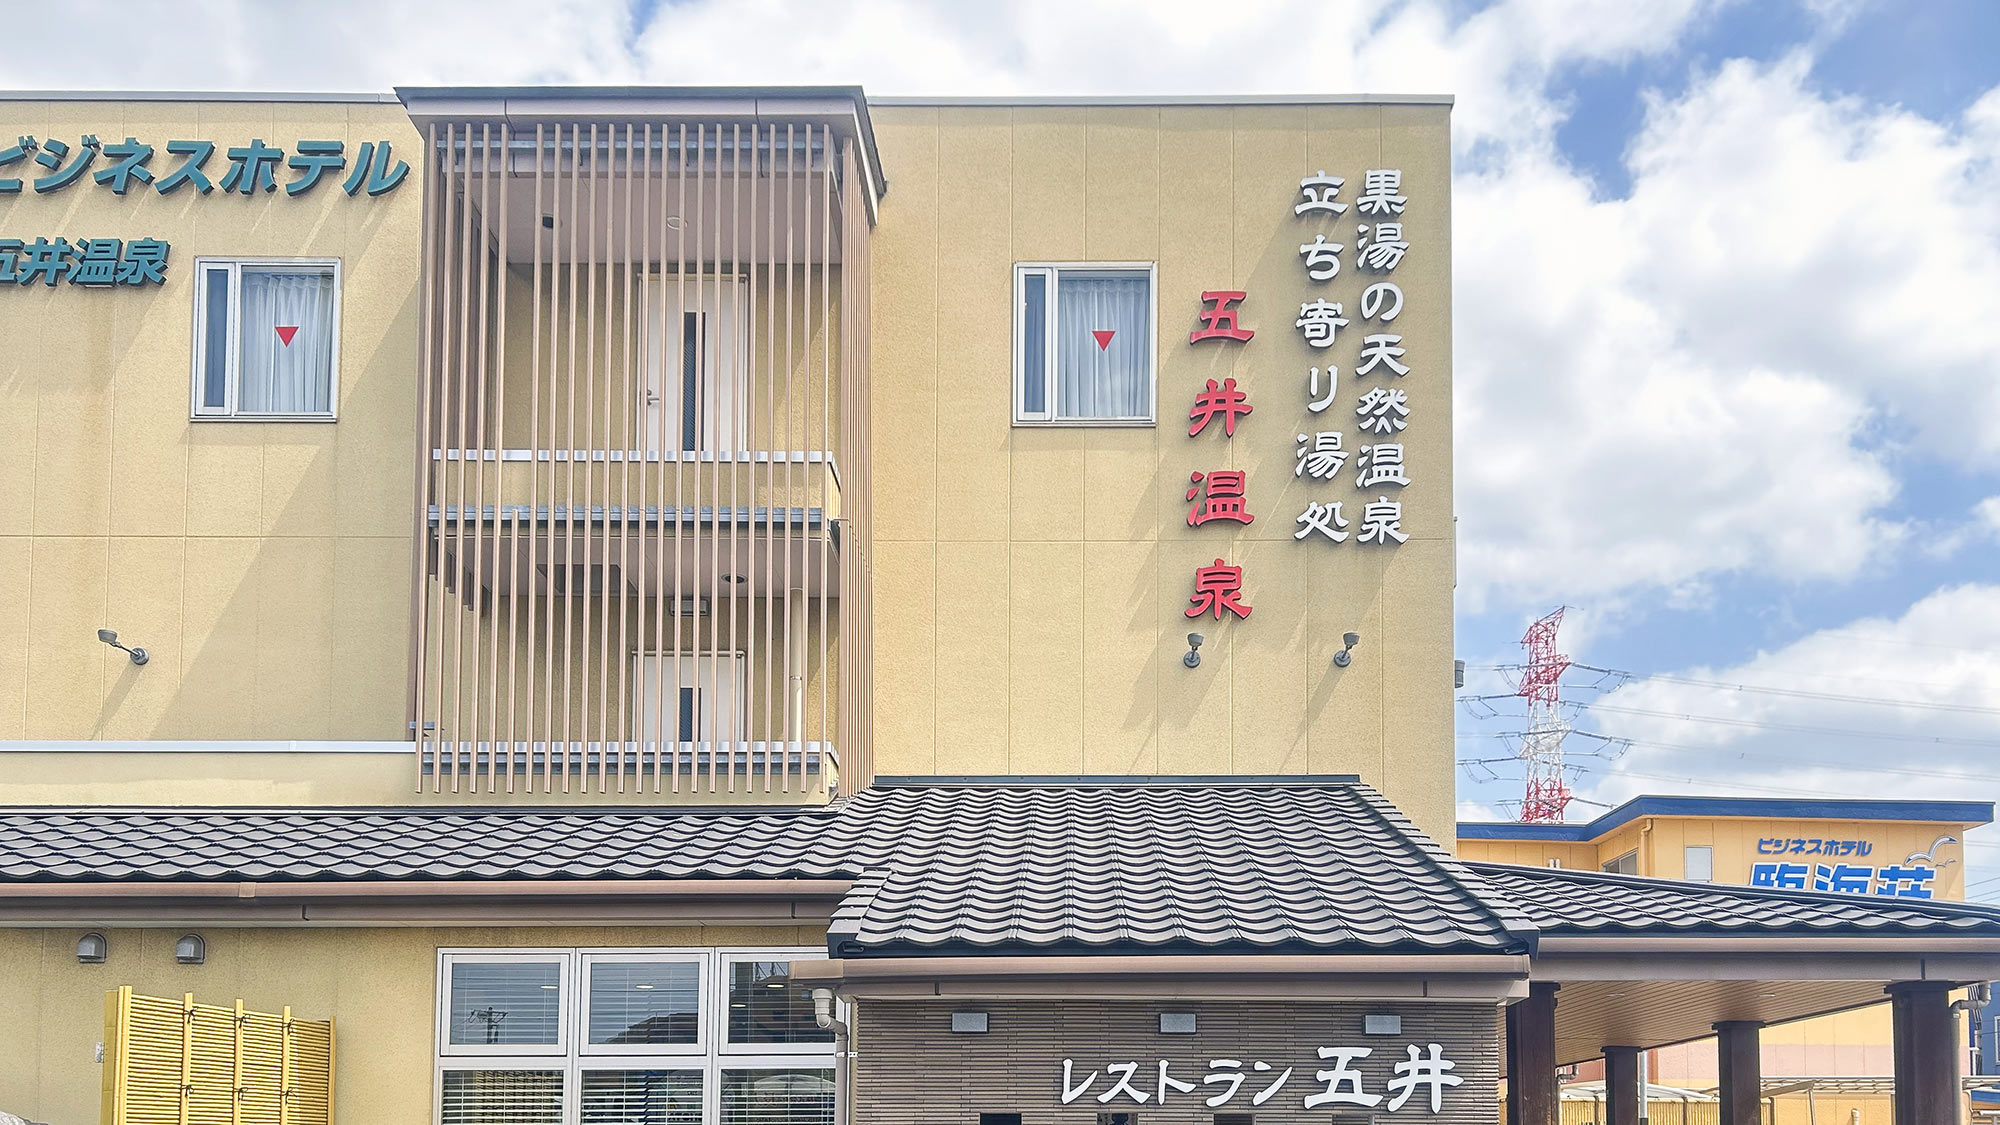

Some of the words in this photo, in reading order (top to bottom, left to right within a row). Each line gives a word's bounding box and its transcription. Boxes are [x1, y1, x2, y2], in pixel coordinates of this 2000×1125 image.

[1185, 290, 1255, 620] 五井温泉
[1294, 169, 1350, 543] 立ち寄り湯処
[1356, 168, 1412, 545] 黒湯の天然温泉
[1757, 838, 1873, 857] ビジネスホテル
